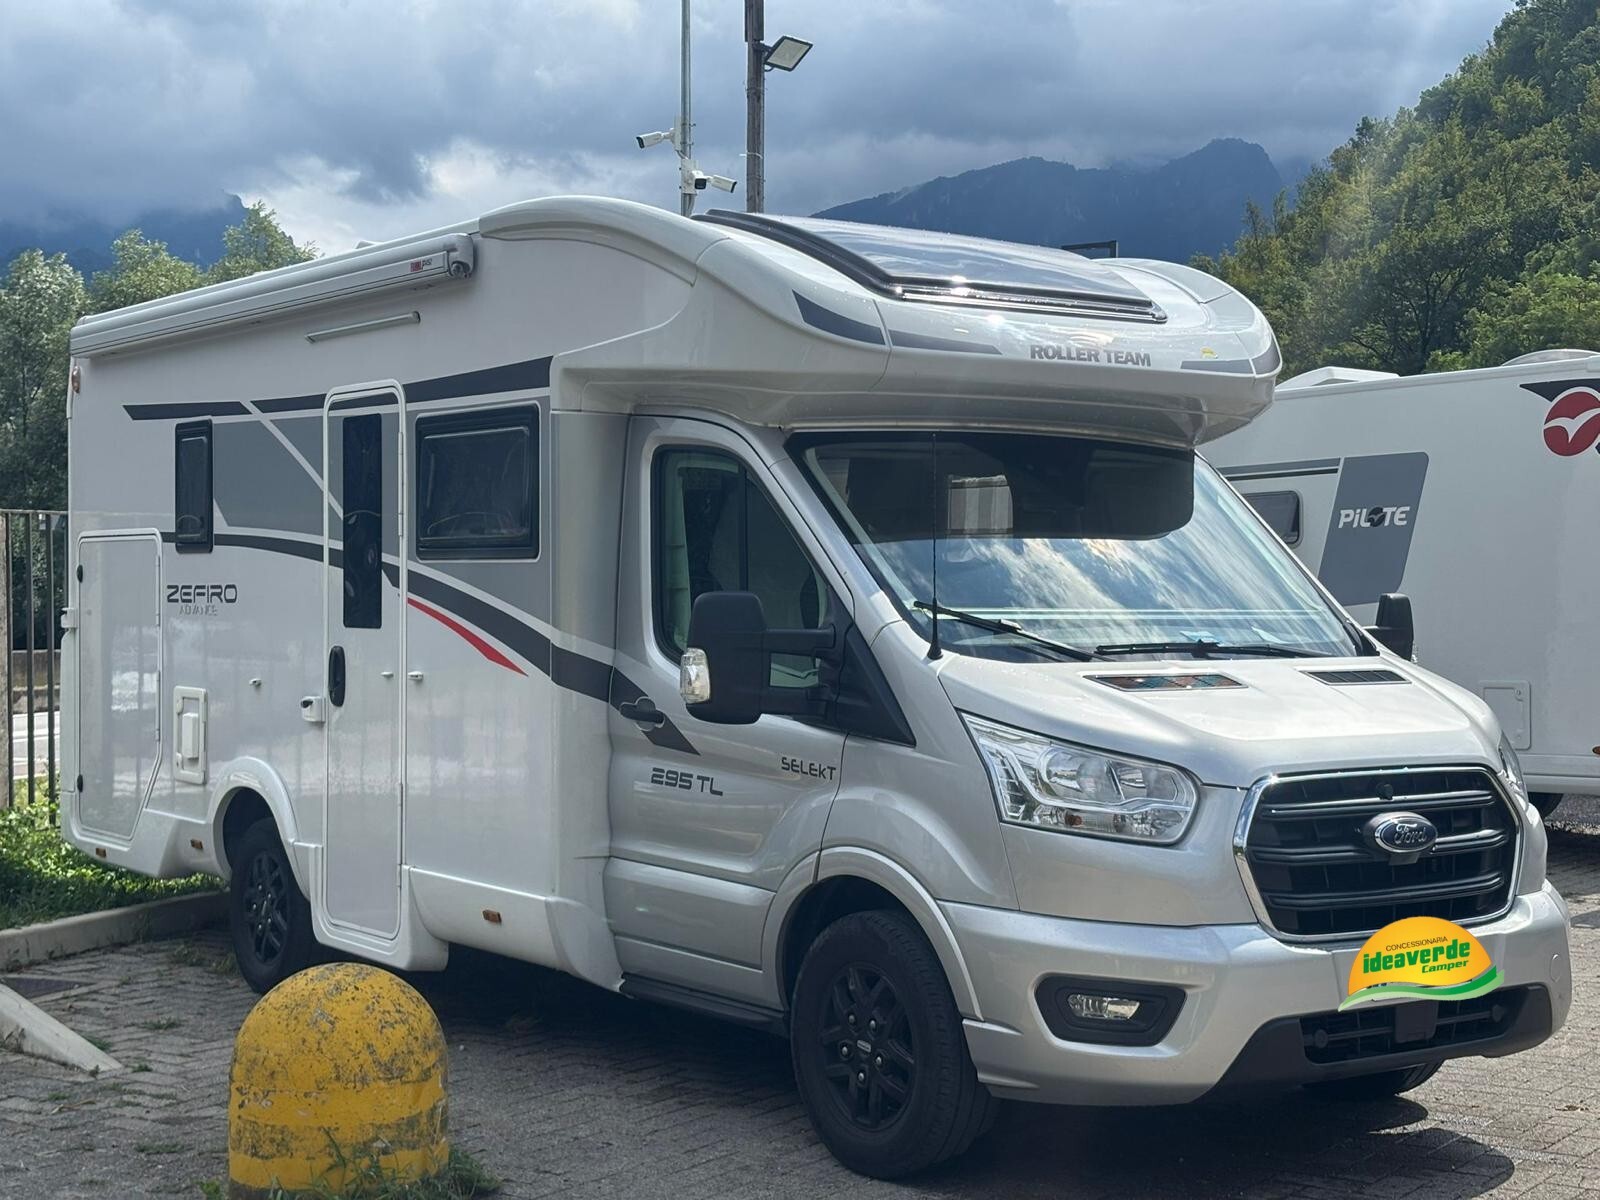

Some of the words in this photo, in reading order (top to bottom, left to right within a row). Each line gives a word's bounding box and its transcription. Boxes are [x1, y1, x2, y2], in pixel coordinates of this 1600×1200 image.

[1030, 344, 1100, 362] ROLLER
[1103, 349, 1152, 367] TEAM
[166, 583, 238, 604] ZEFIRO
[781, 756, 837, 781] SELEKT
[696, 774, 724, 797] TL
[1393, 822, 1428, 845] Ford
